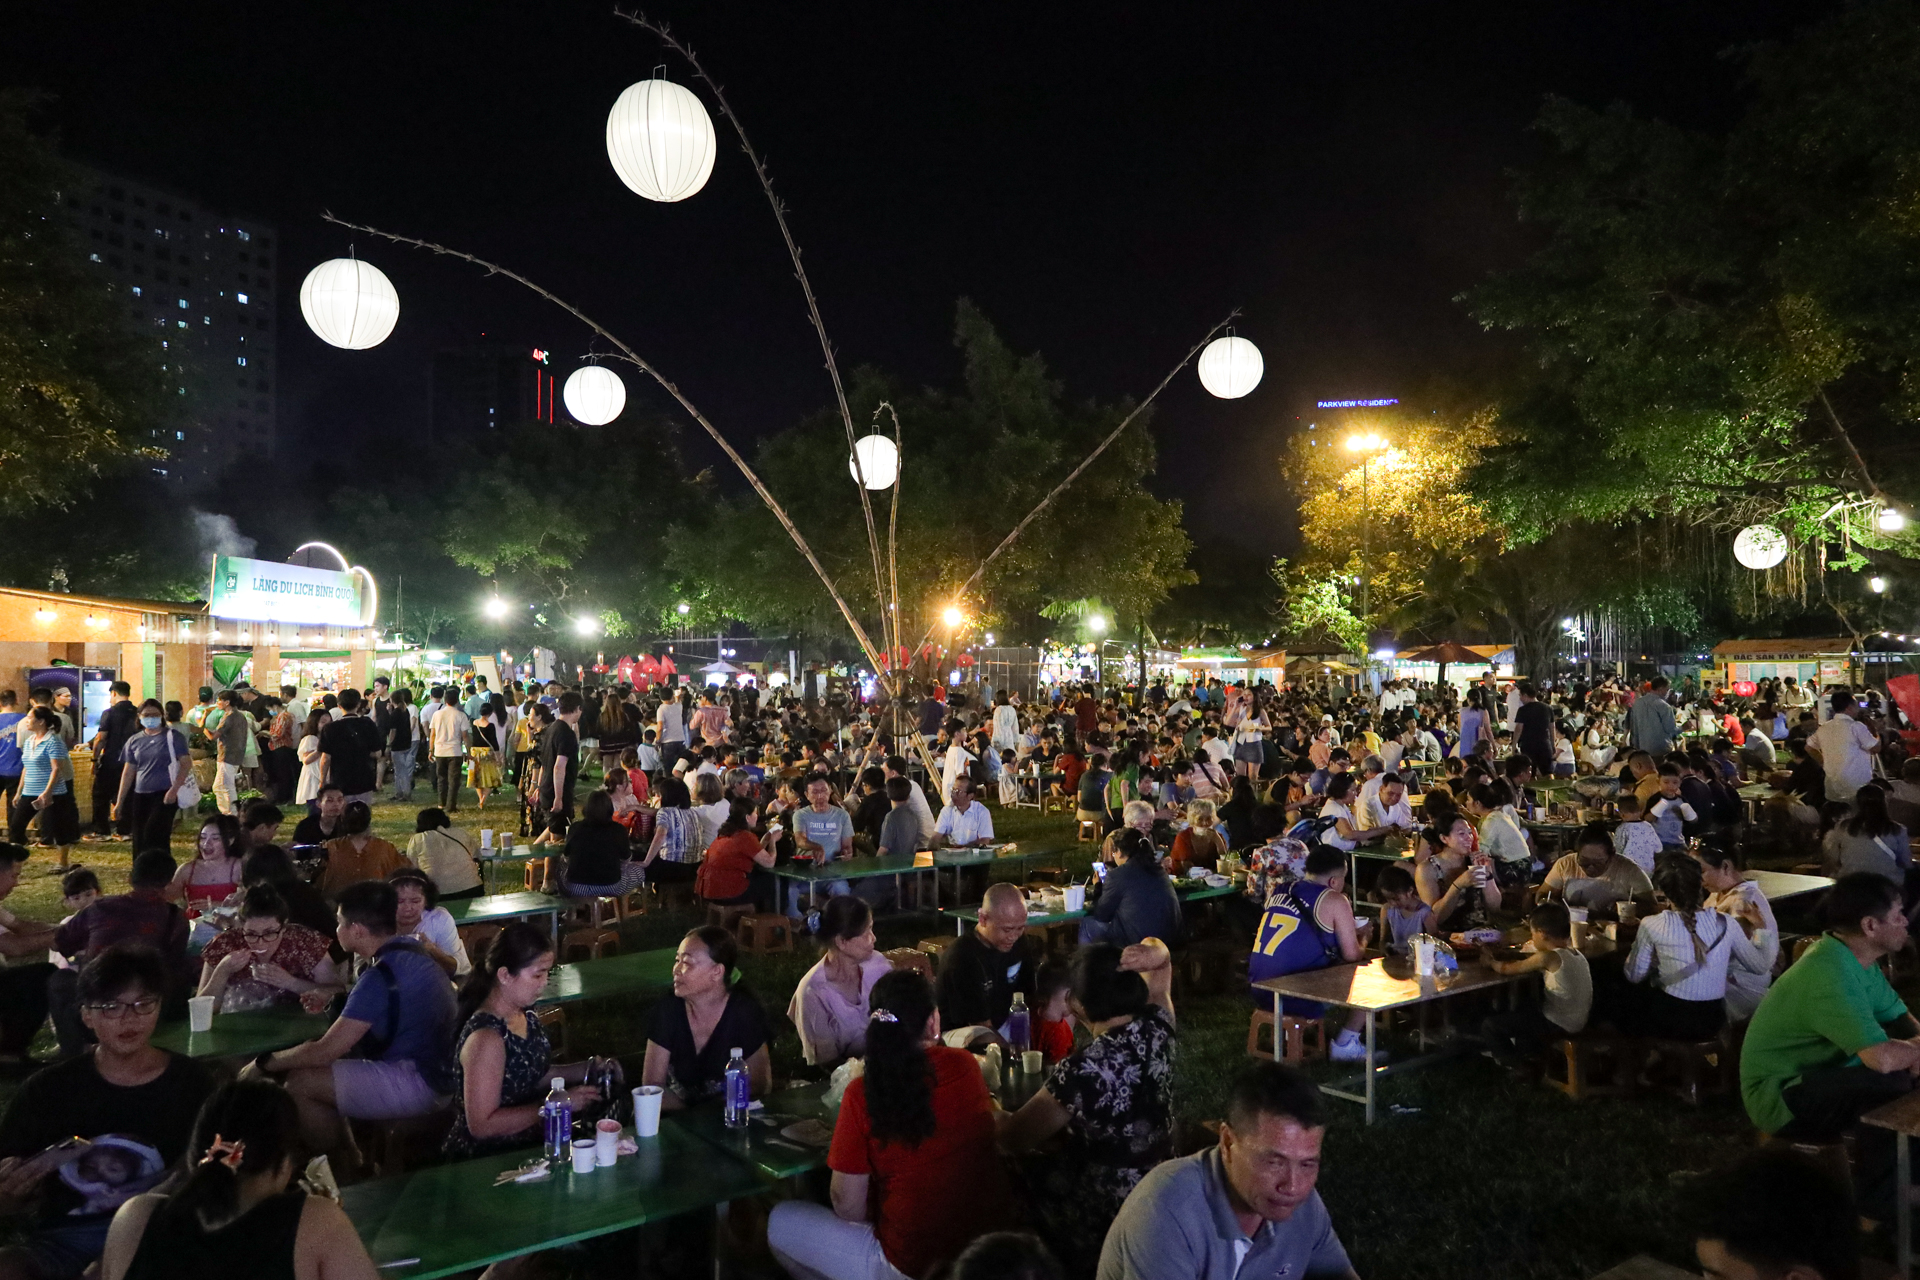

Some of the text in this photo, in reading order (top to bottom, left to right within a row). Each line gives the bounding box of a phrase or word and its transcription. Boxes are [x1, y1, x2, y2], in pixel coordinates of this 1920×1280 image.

[253, 575, 278, 592] LÀNG
[280, 581, 293, 594] DU
[1252, 911, 1301, 956] 17
